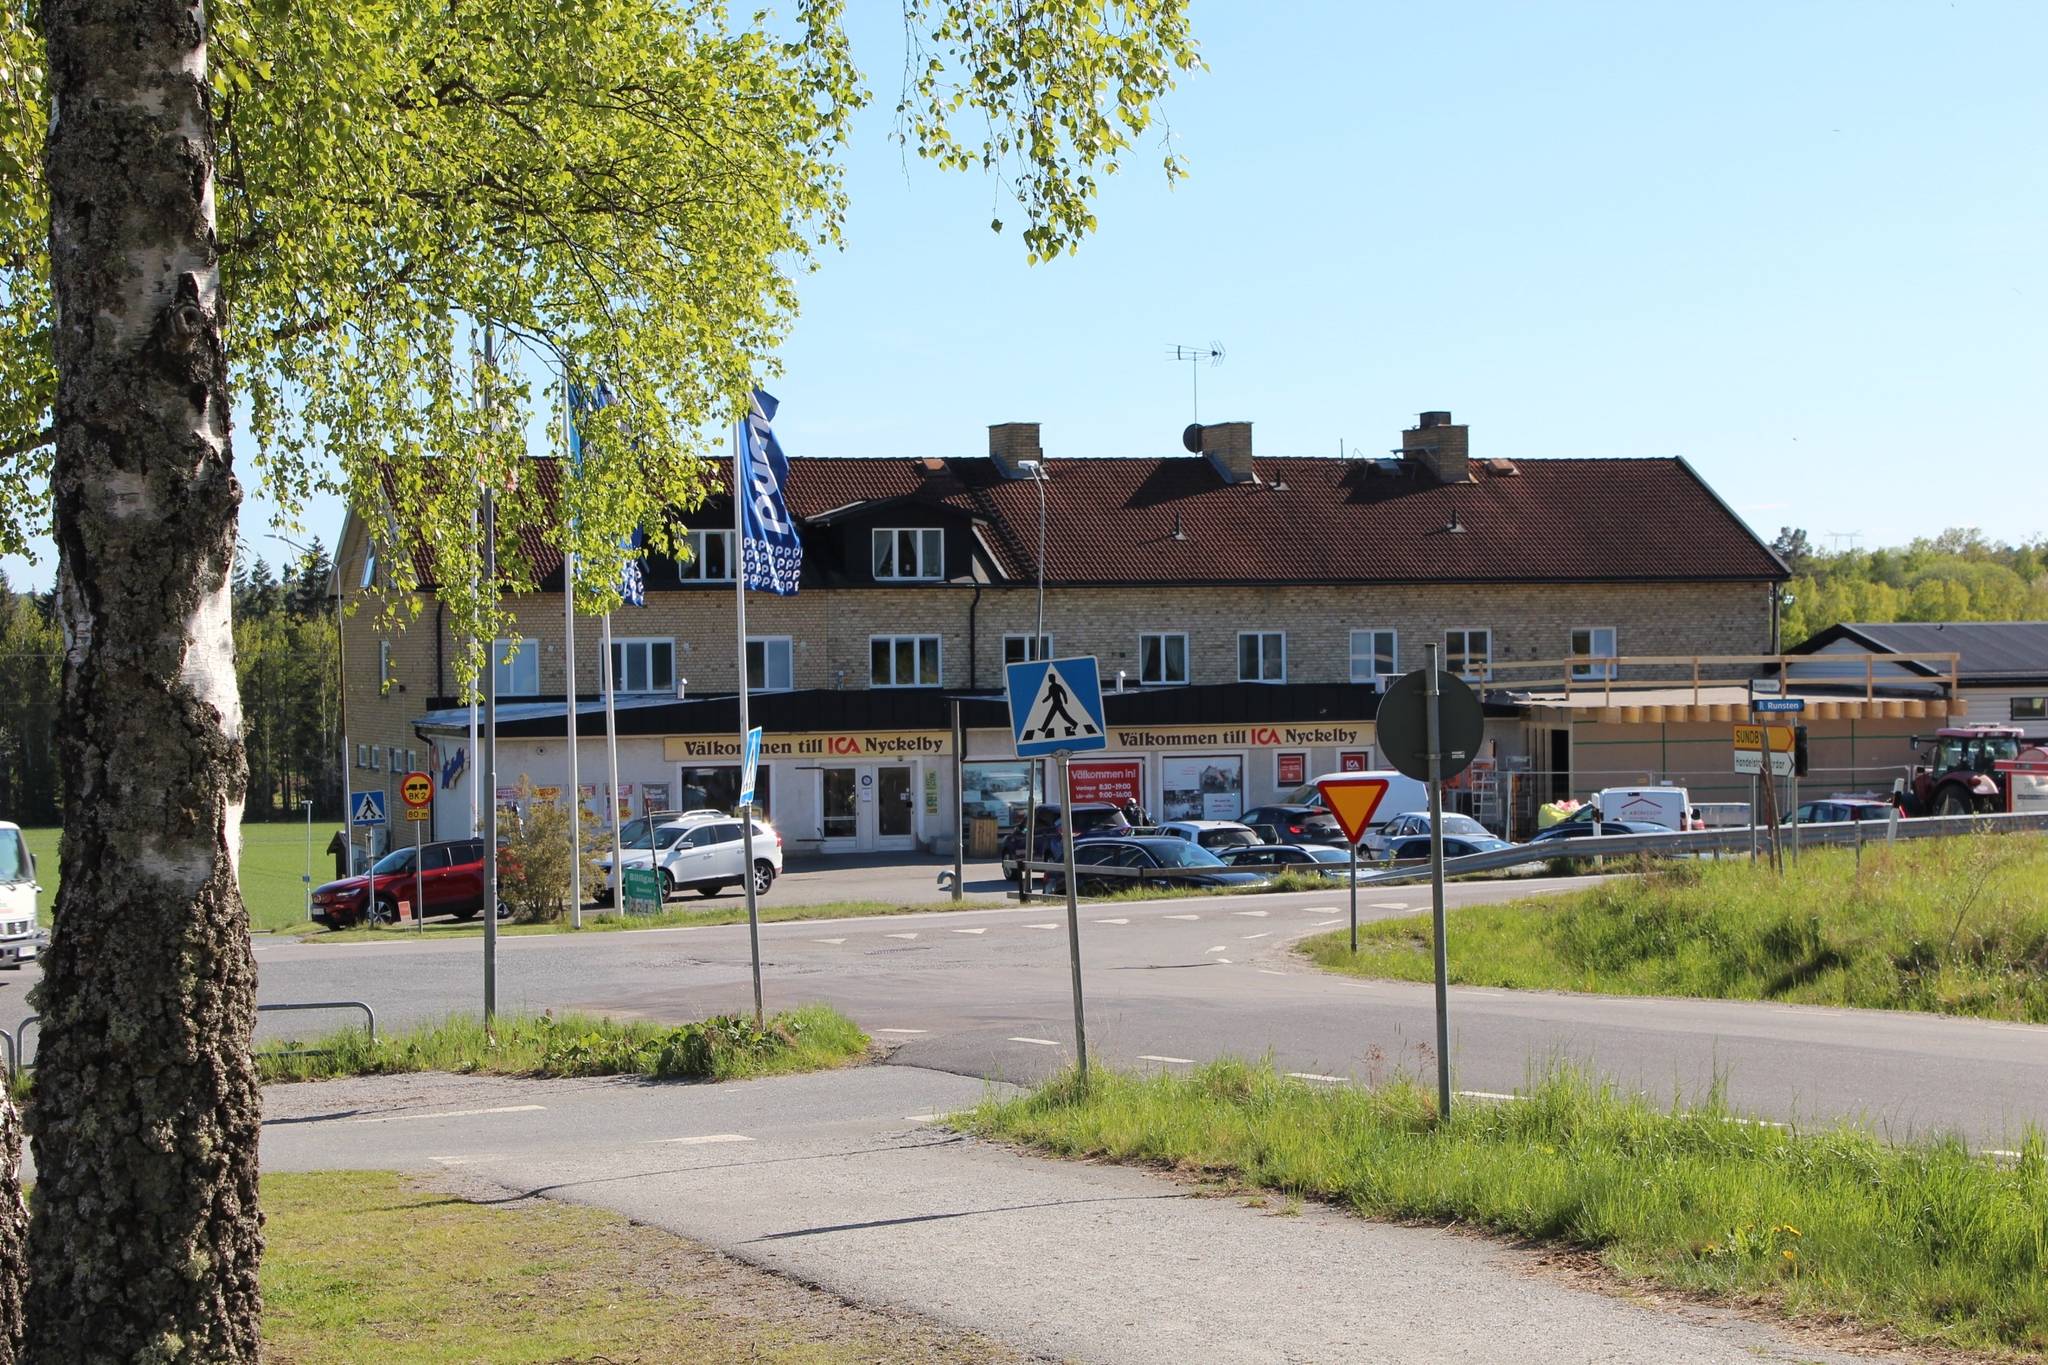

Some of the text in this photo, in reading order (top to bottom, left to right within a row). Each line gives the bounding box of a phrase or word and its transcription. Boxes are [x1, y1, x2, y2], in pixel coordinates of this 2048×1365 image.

[1768, 701, 1800, 710] Runsten
[1118, 728, 1358, 747] Välkommen till ICA Nyckelby
[798, 738, 823, 753] till
[828, 737, 861, 754] ICA
[865, 736, 943, 754] Nyckelby
[1346, 760, 1359, 768] ICA
[1071, 769, 1124, 780] Välkommen
